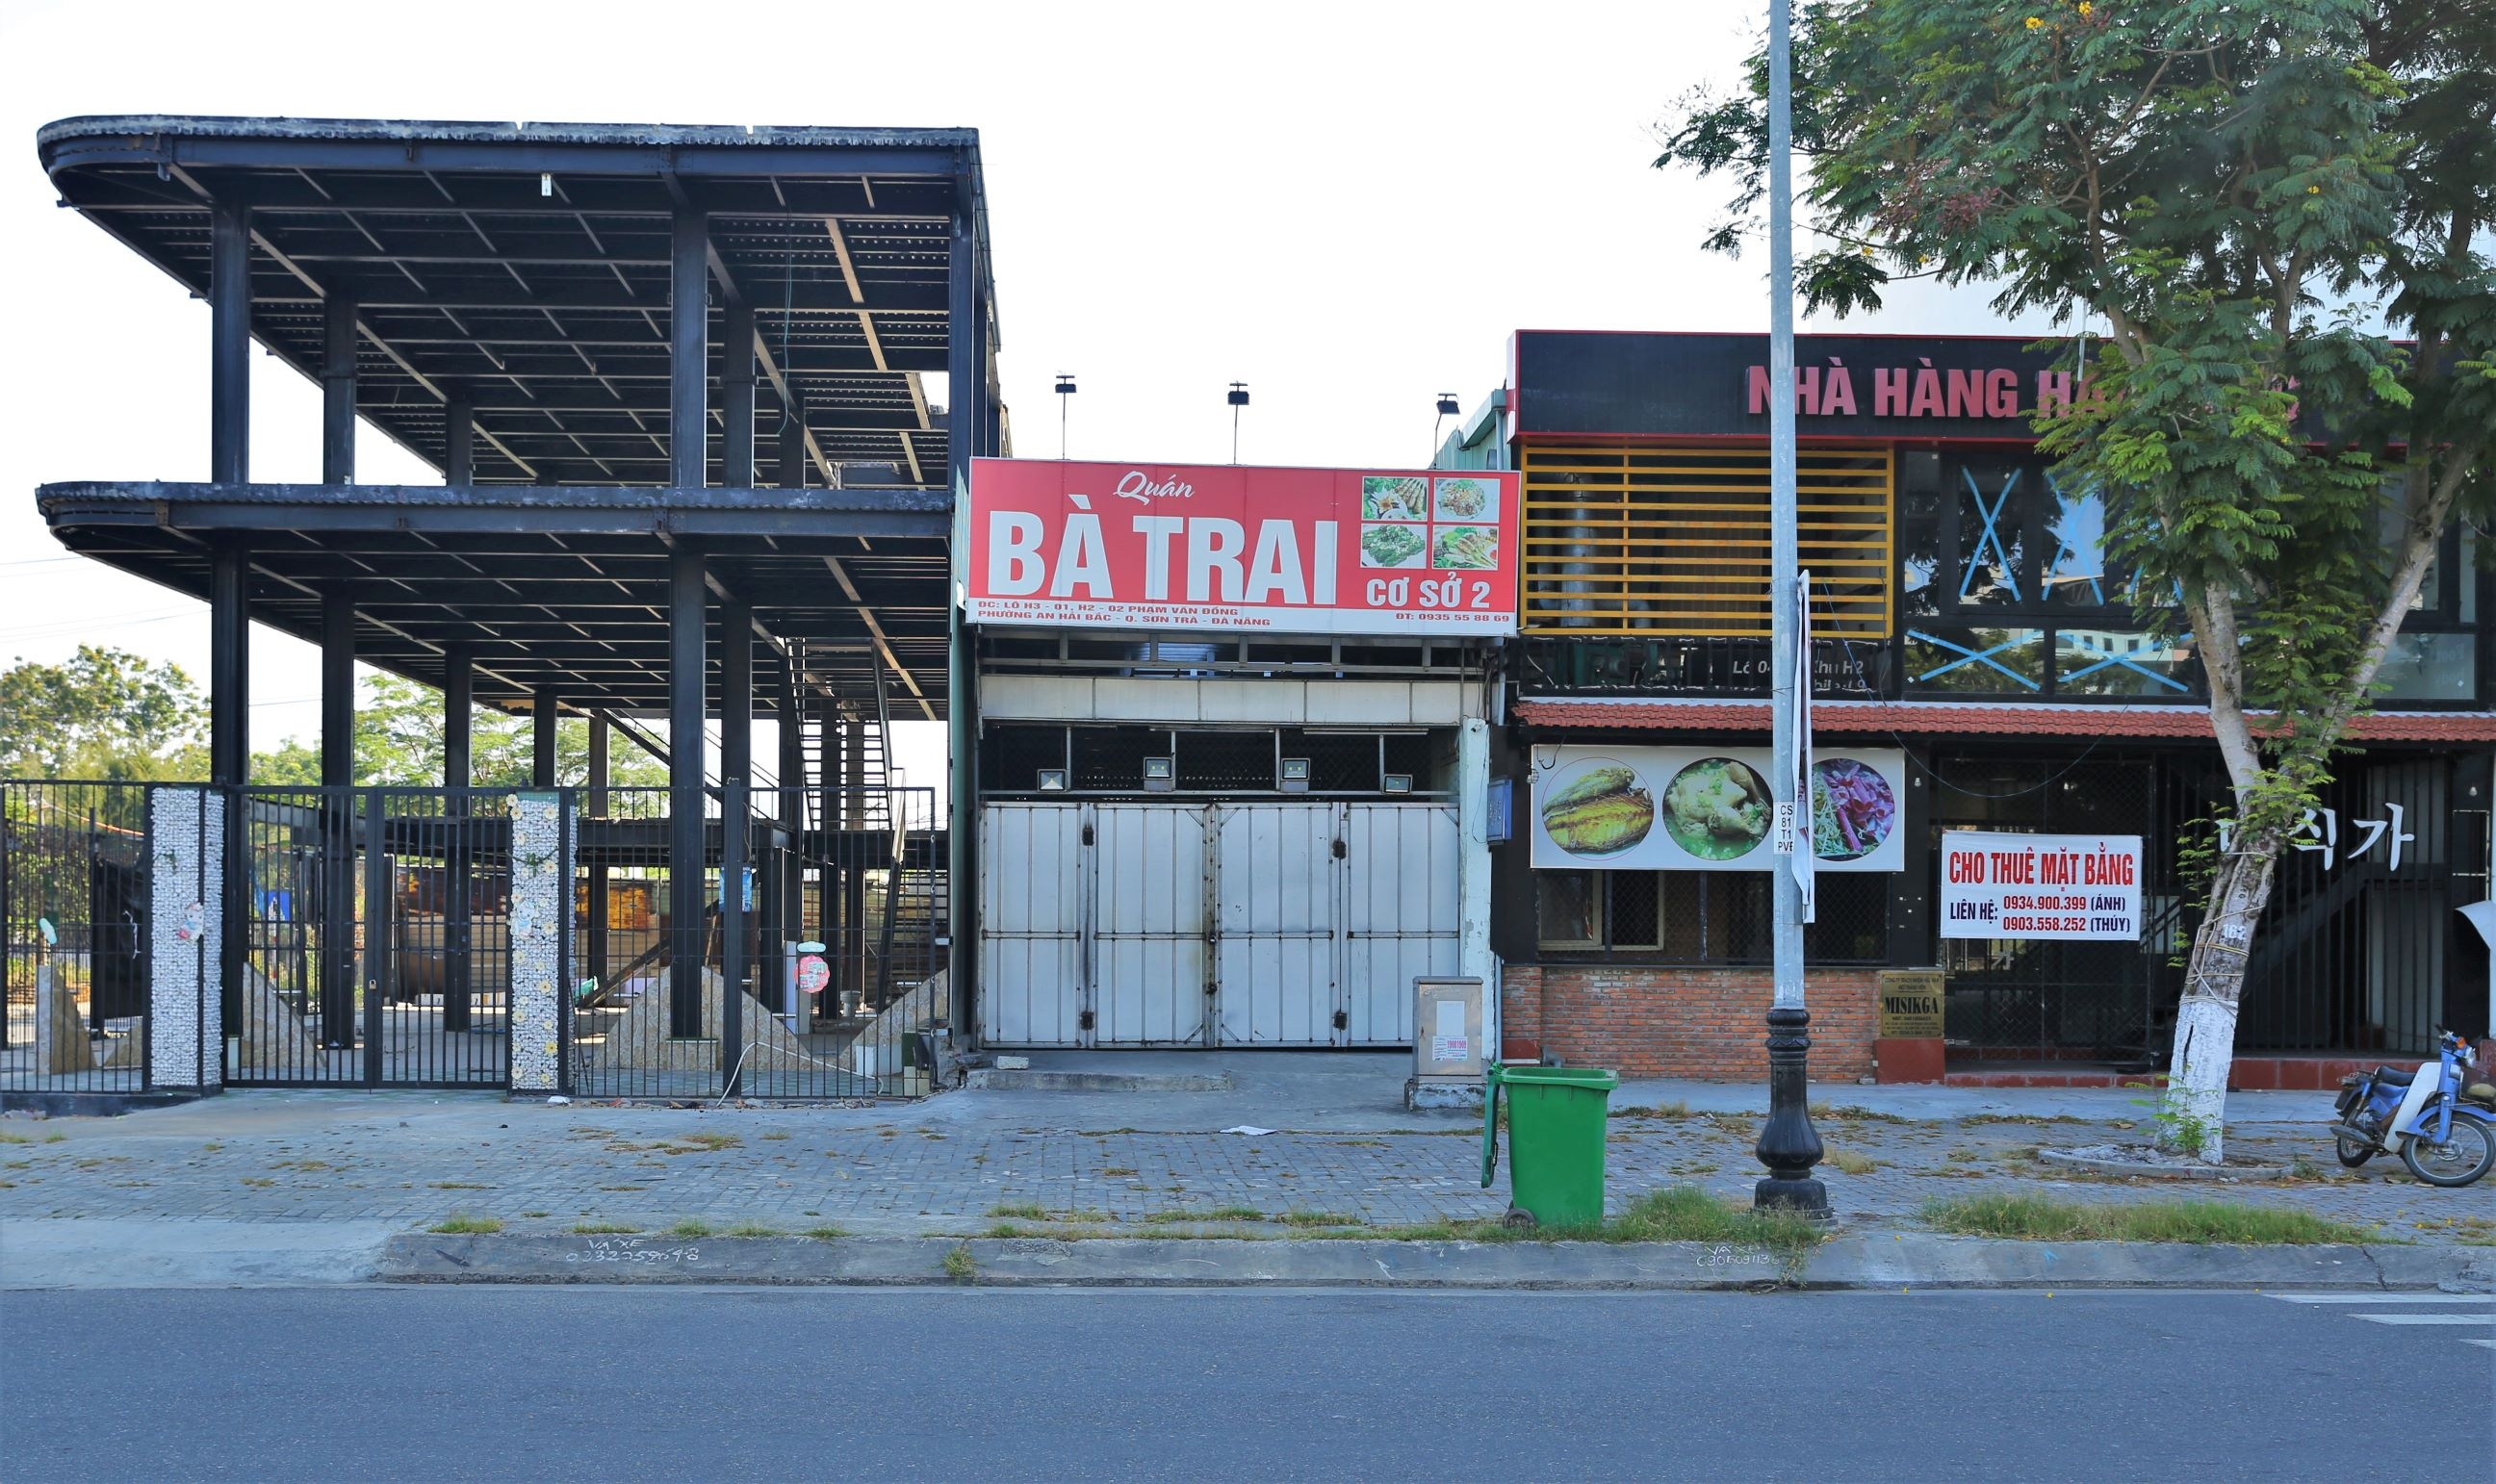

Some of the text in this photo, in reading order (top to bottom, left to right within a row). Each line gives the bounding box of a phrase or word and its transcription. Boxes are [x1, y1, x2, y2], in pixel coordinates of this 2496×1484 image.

[1748, 356, 1858, 416] NHÀ
[1874, 356, 2019, 418] HÀNG
[1113, 471, 1195, 506] Quán
[988, 494, 1338, 605] BÀ TRAI
[1366, 571, 1490, 608] CƠ SỞ 2
[1004, 601, 1019, 609] LÔ
[1128, 606, 1167, 616] PHẠM
[1142, 615, 1170, 624] SƠN
[1173, 615, 1198, 624] TRÀ
[1211, 616, 1229, 625] ĐÀ
[1780, 805, 1793, 816] CS
[1781, 817, 1791, 828] 81
[1781, 829, 1791, 839] T1
[1949, 842, 2133, 891] CHO THUÊ MẶT BẰNG
[1950, 899, 1998, 924] LIÊN HỆ:
[2003, 894, 2125, 912] 0934.900.399 (ÁNH)
[2003, 916, 2130, 934] 0903.558.252 (THÚY)
[1885, 996, 1939, 1014] MISIKGA
